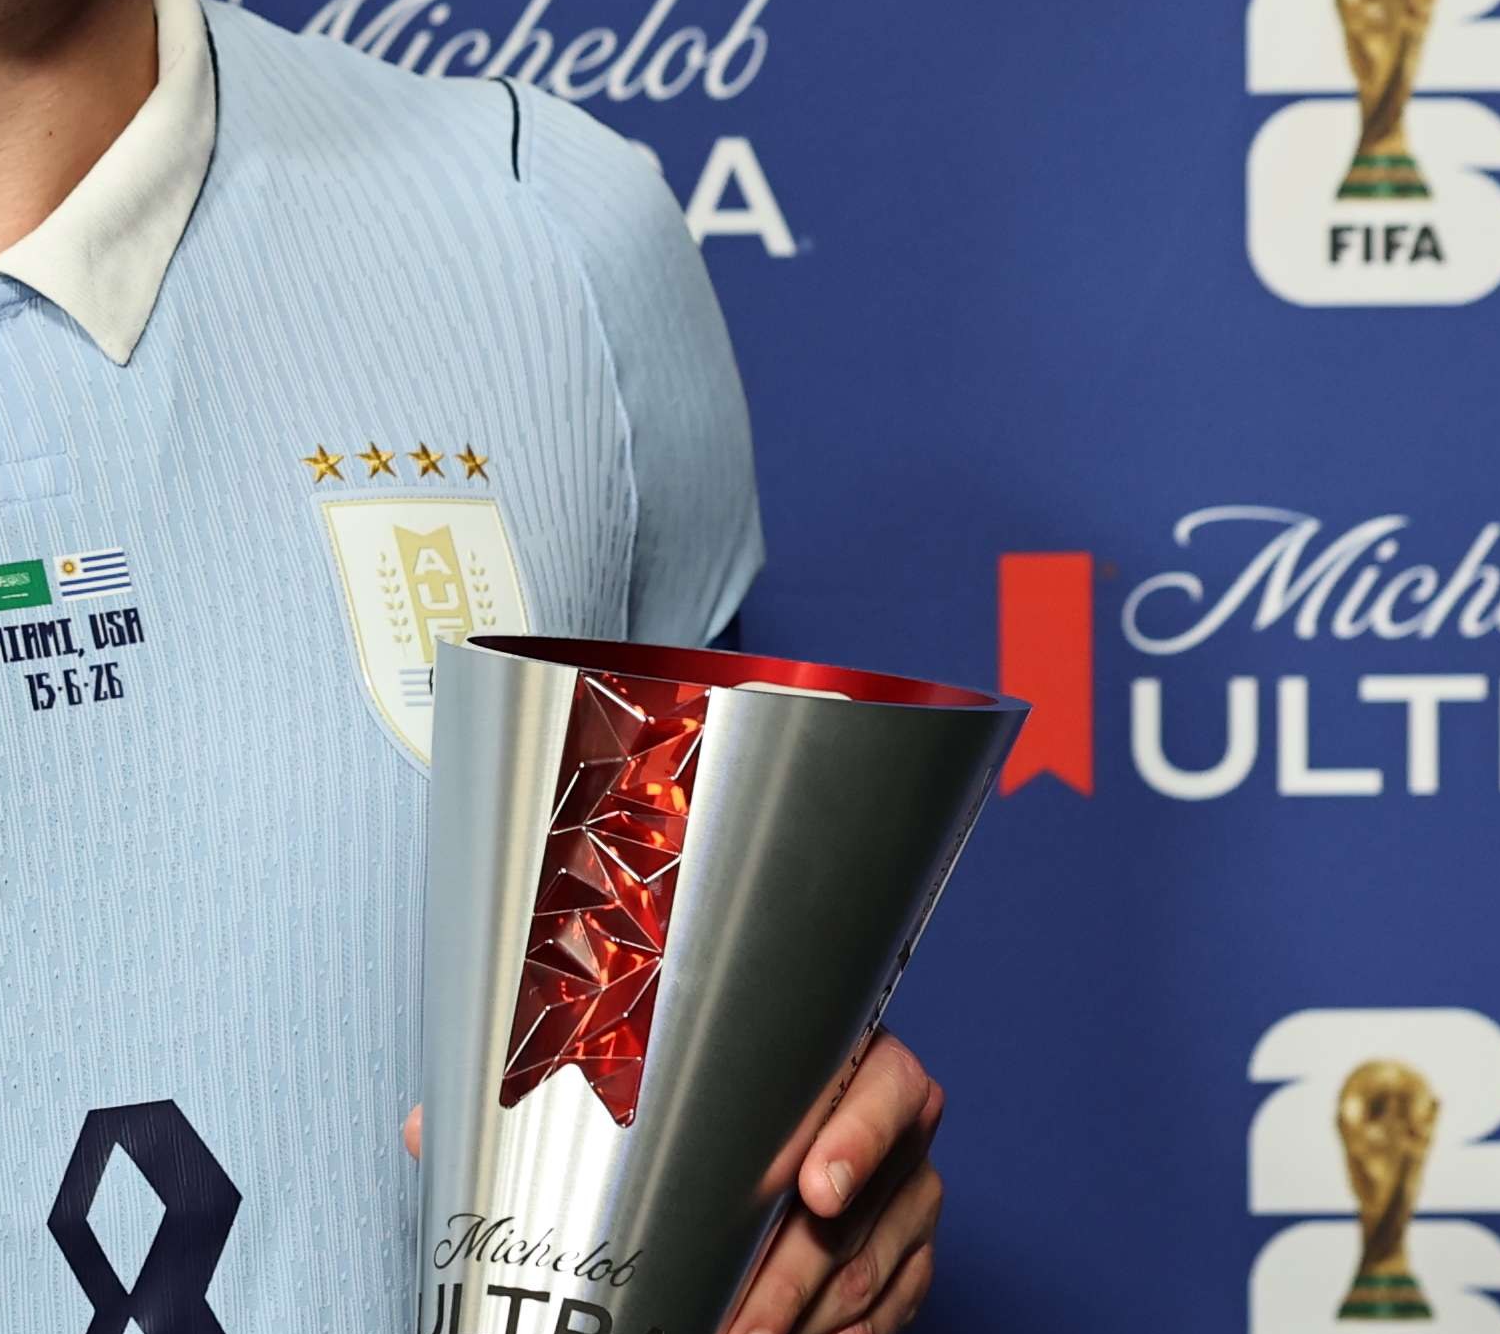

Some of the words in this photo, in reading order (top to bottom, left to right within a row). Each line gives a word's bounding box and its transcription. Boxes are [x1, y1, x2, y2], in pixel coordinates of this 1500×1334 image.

[1327, 222, 1447, 266] FIFA
[88, 607, 145, 651] USA
[433, 1212, 645, 1289] Michelob
